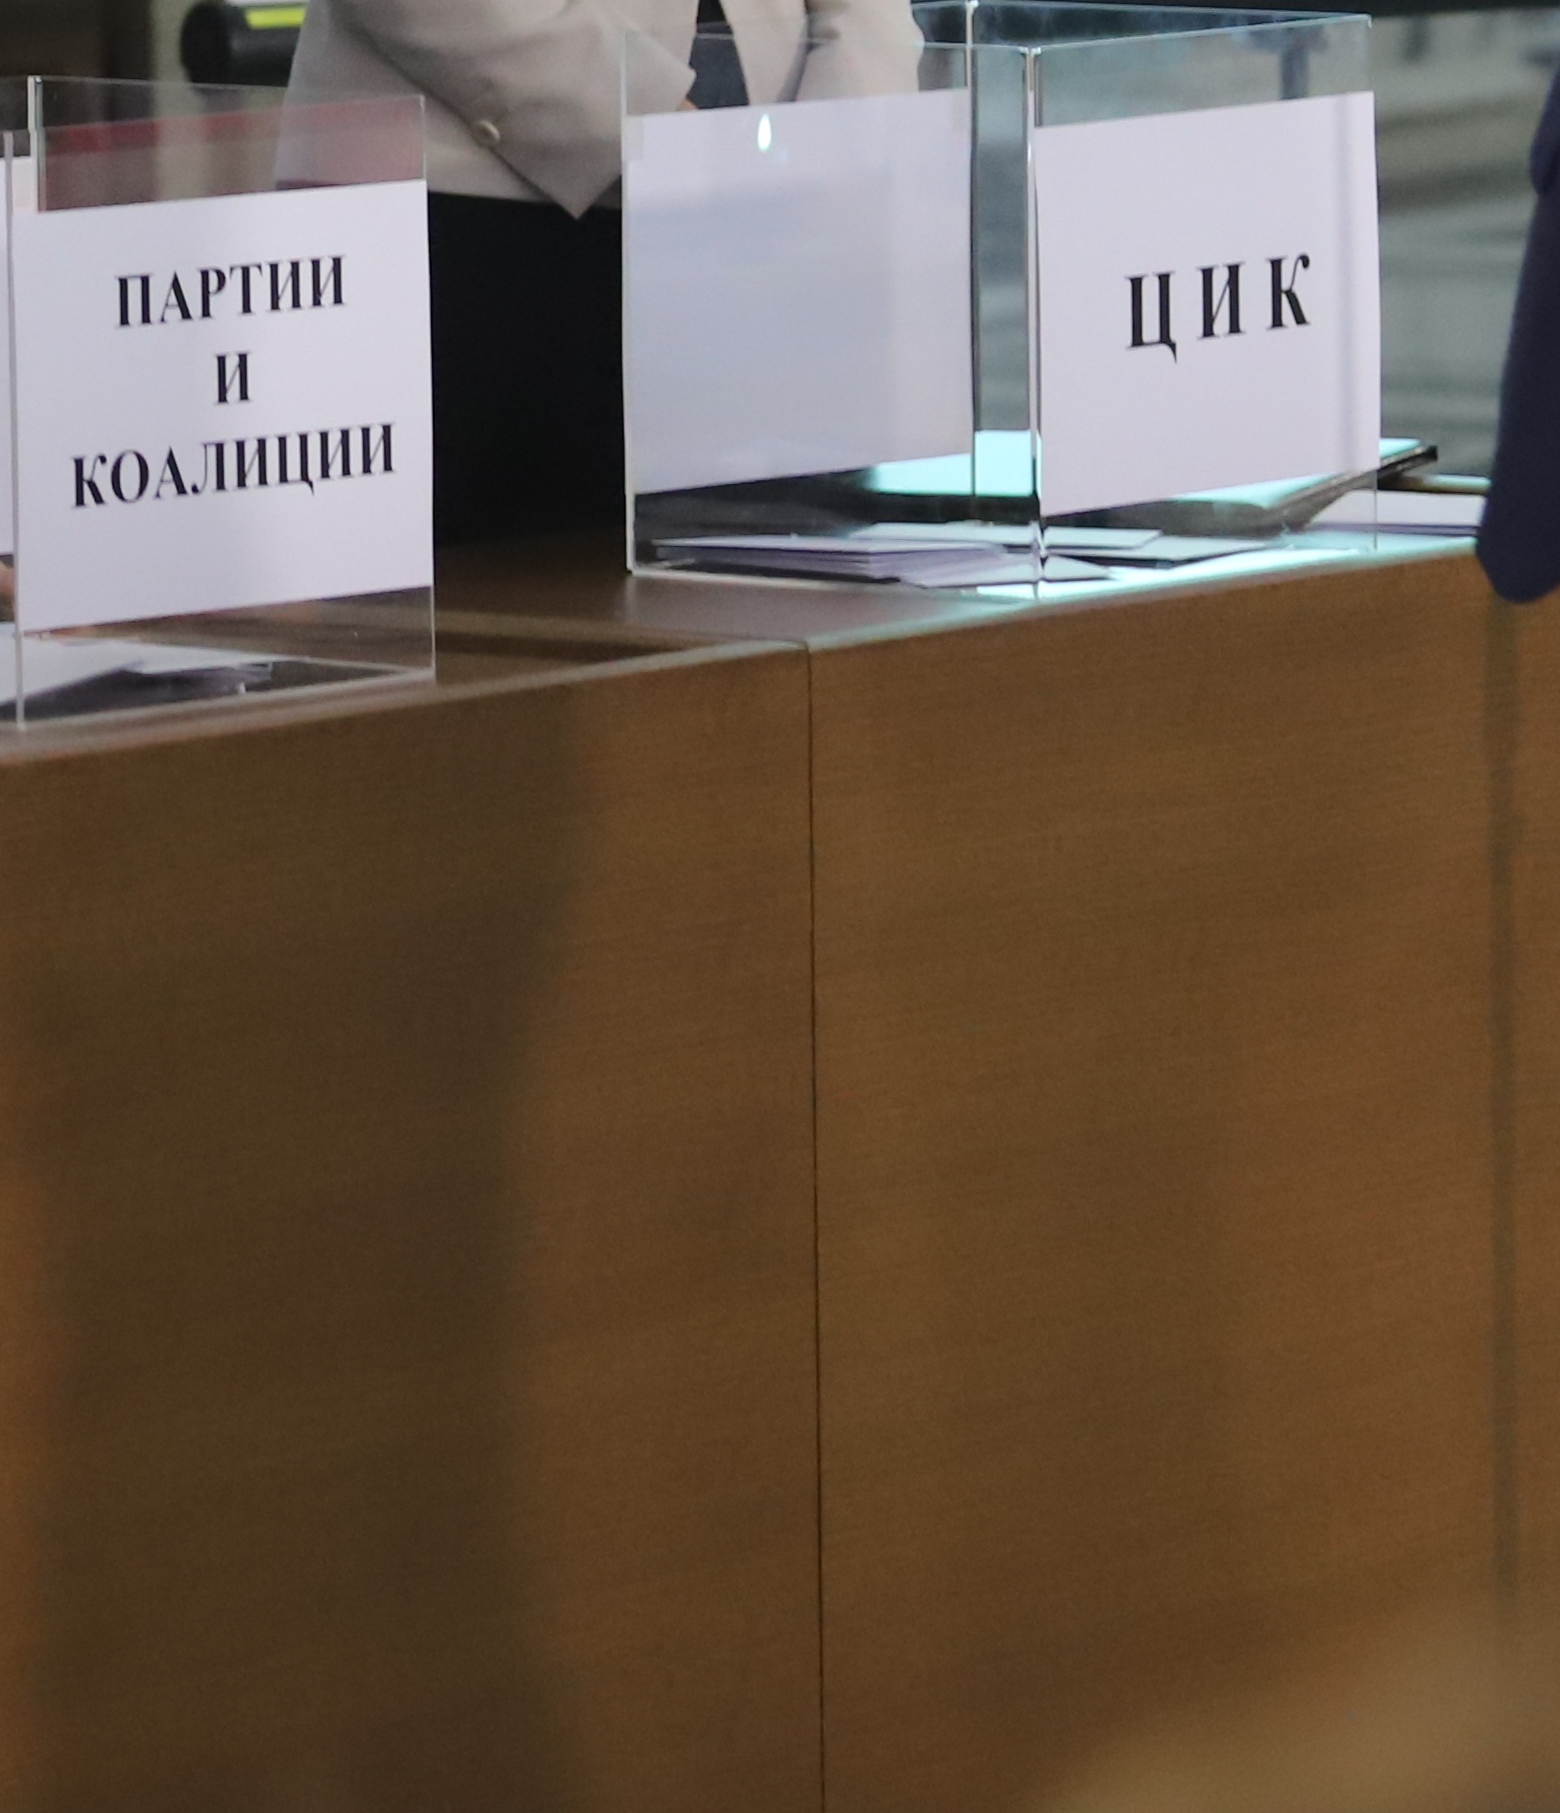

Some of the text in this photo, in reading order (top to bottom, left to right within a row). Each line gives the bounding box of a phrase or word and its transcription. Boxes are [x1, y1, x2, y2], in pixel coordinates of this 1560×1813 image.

[114, 254, 346, 329] ПАРТИИ
[1124, 251, 1312, 365] ЦИК
[212, 349, 252, 406] И
[71, 422, 396, 510] КОАЛИЦИИ
